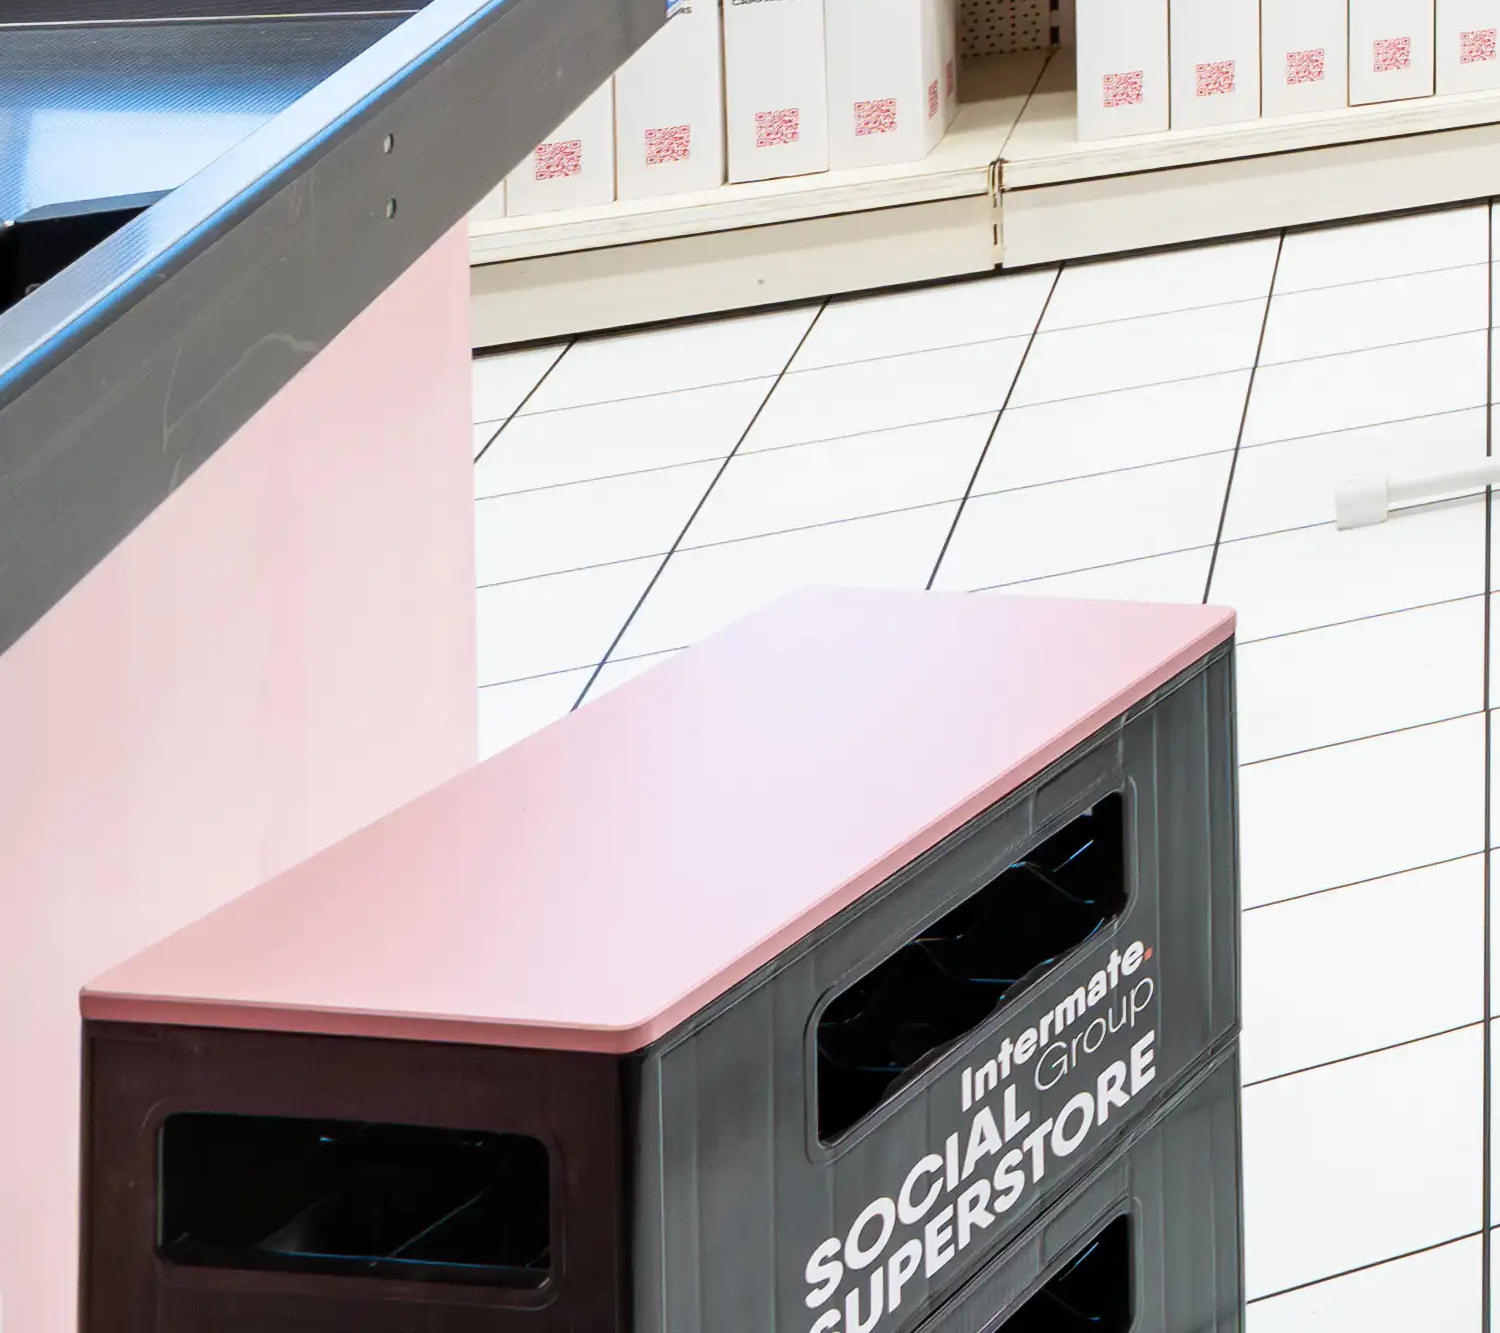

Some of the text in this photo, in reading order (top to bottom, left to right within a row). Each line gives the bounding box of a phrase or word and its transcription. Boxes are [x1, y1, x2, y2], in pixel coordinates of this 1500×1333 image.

[962, 941, 1152, 1112] Intermate.
[1035, 977, 1153, 1090] Group
[807, 1084, 1030, 1308] SOCIAL
